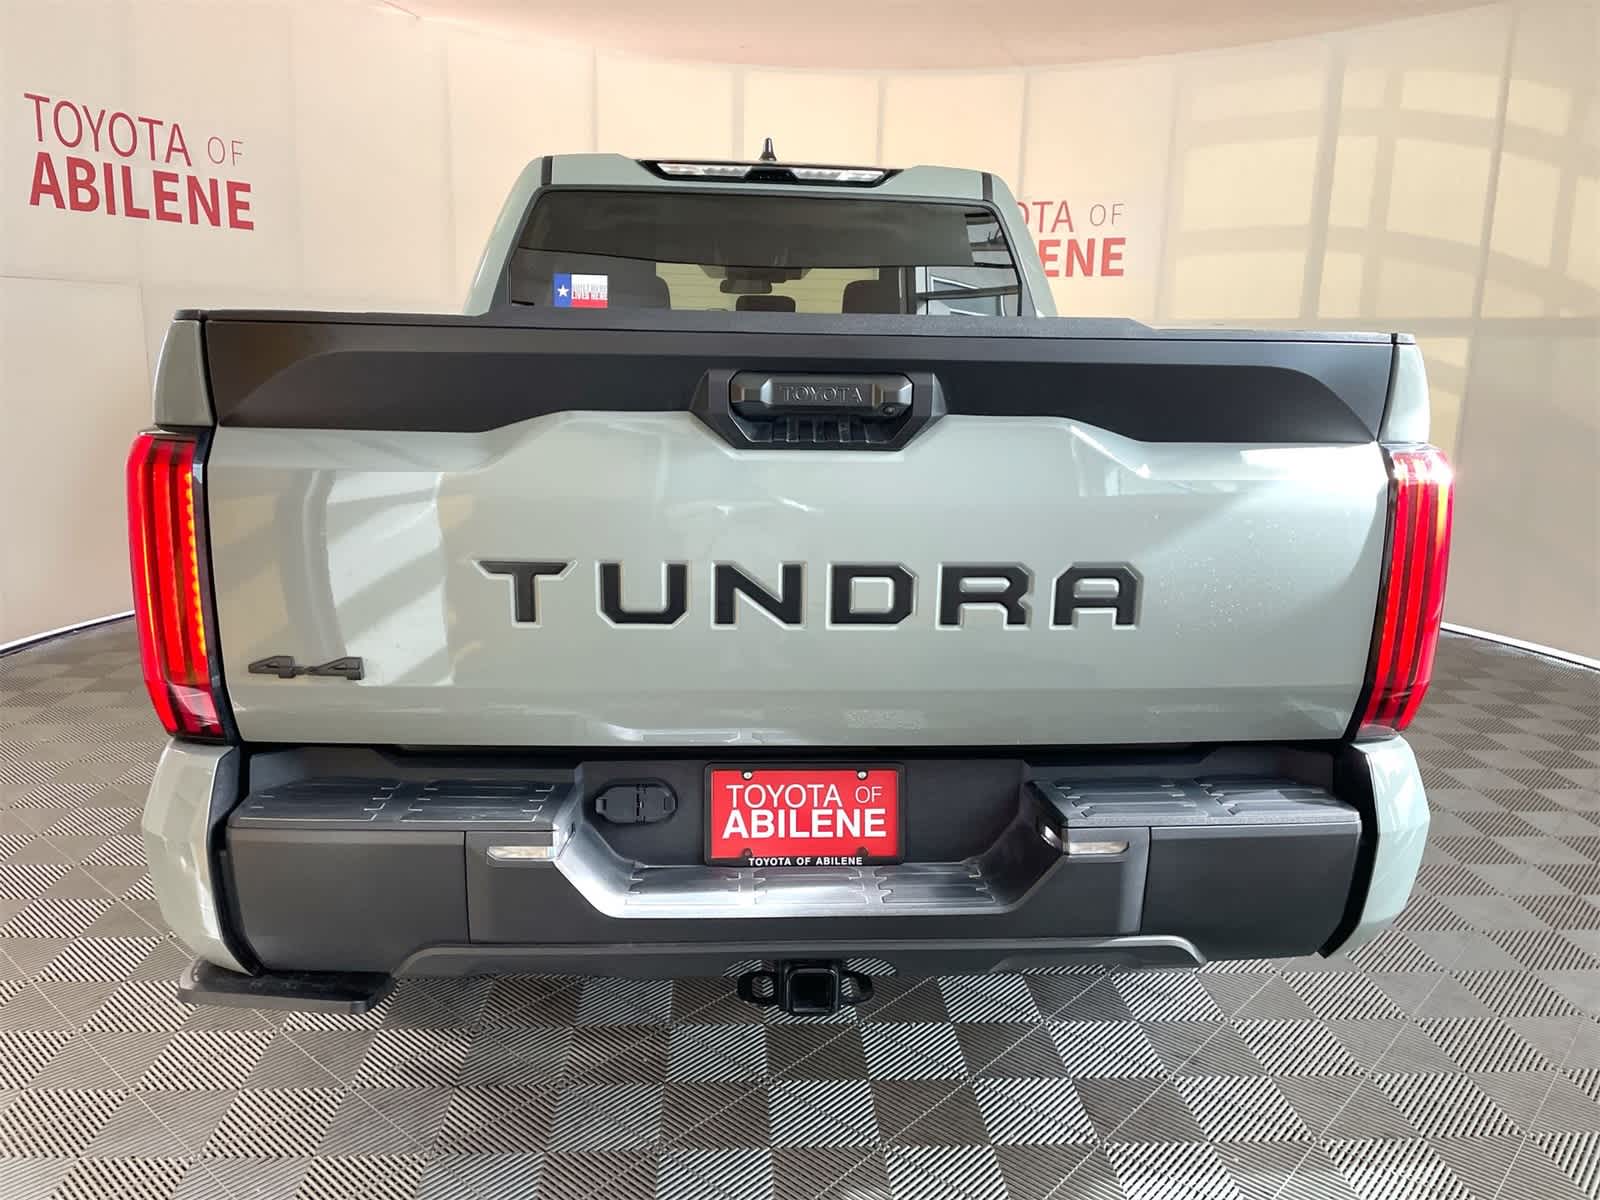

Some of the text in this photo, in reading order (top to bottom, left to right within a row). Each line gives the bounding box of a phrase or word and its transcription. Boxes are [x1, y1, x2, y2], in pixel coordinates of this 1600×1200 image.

[24, 92, 244, 167] TOYOTA OF
[29, 151, 254, 231] ABILENE
[1089, 203, 1125, 227] OF
[780, 385, 864, 403] TOYOTA
[472, 560, 1144, 630] TUNDRA
[726, 783, 882, 809] TOYOTA OF
[722, 808, 887, 839] ABILENE
[748, 856, 863, 866] TOYOTA OF ABILENE
